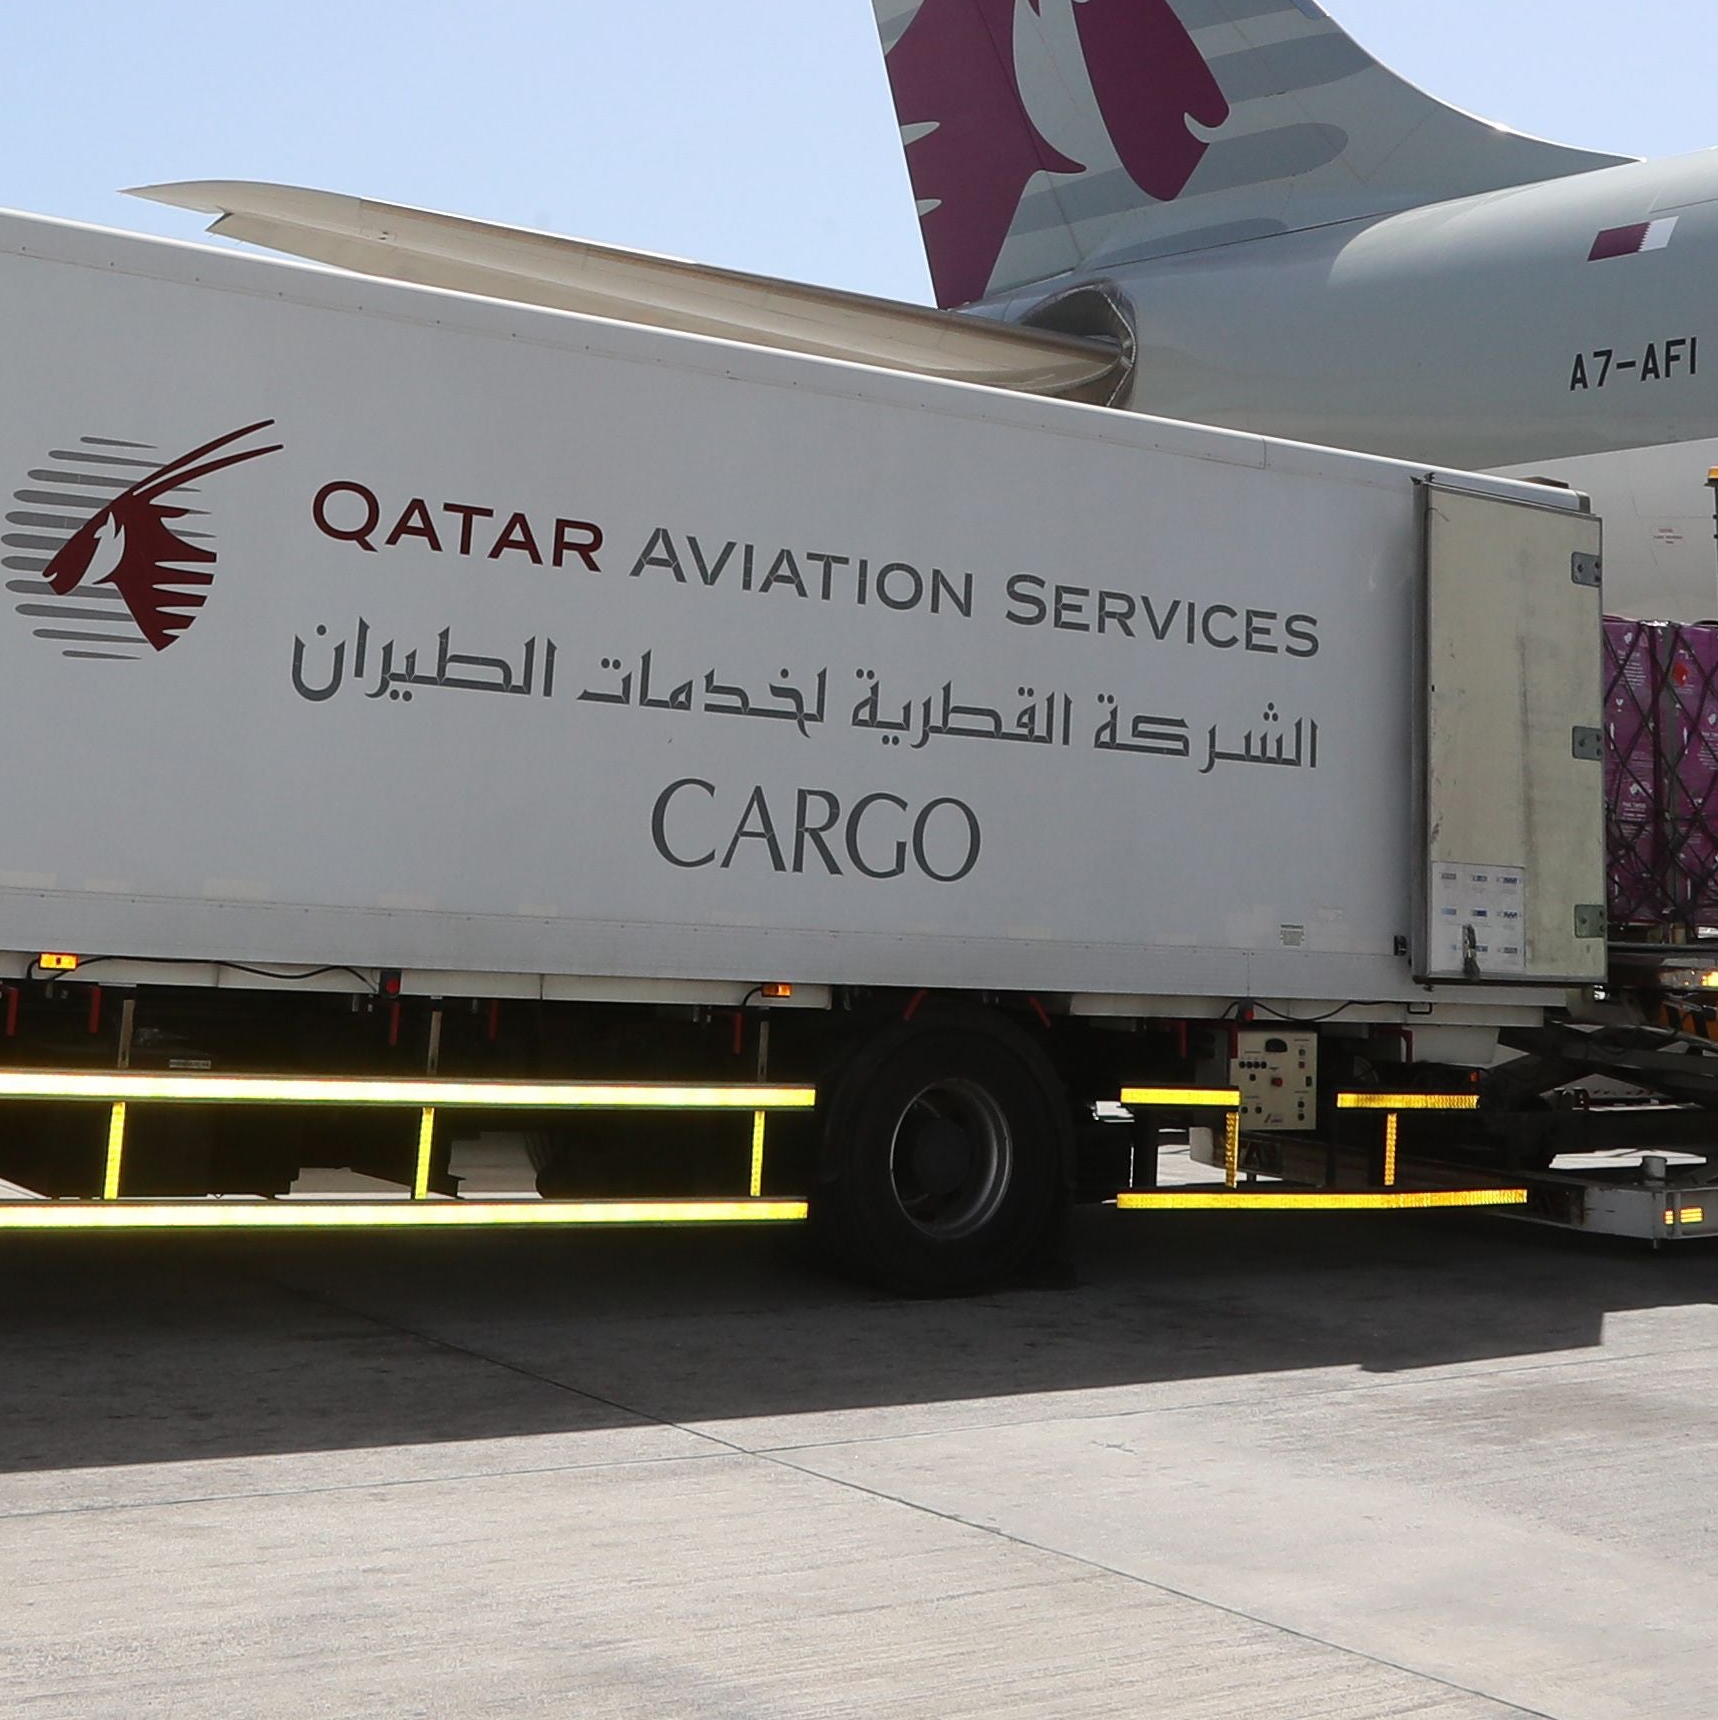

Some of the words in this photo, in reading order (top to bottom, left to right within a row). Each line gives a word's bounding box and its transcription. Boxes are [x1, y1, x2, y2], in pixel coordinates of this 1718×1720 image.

[1569, 336, 1698, 392] A7-AFI
[312, 480, 604, 574] QATAR
[628, 527, 974, 618] AVIATION
[1005, 573, 1320, 658] SERVICES
[291, 616, 558, 702] الطيران
[576, 648, 828, 739] لخدمات
[850, 668, 1073, 750] القطرية
[1093, 693, 1319, 774] الشركة
[651, 776, 982, 885] CARGO
